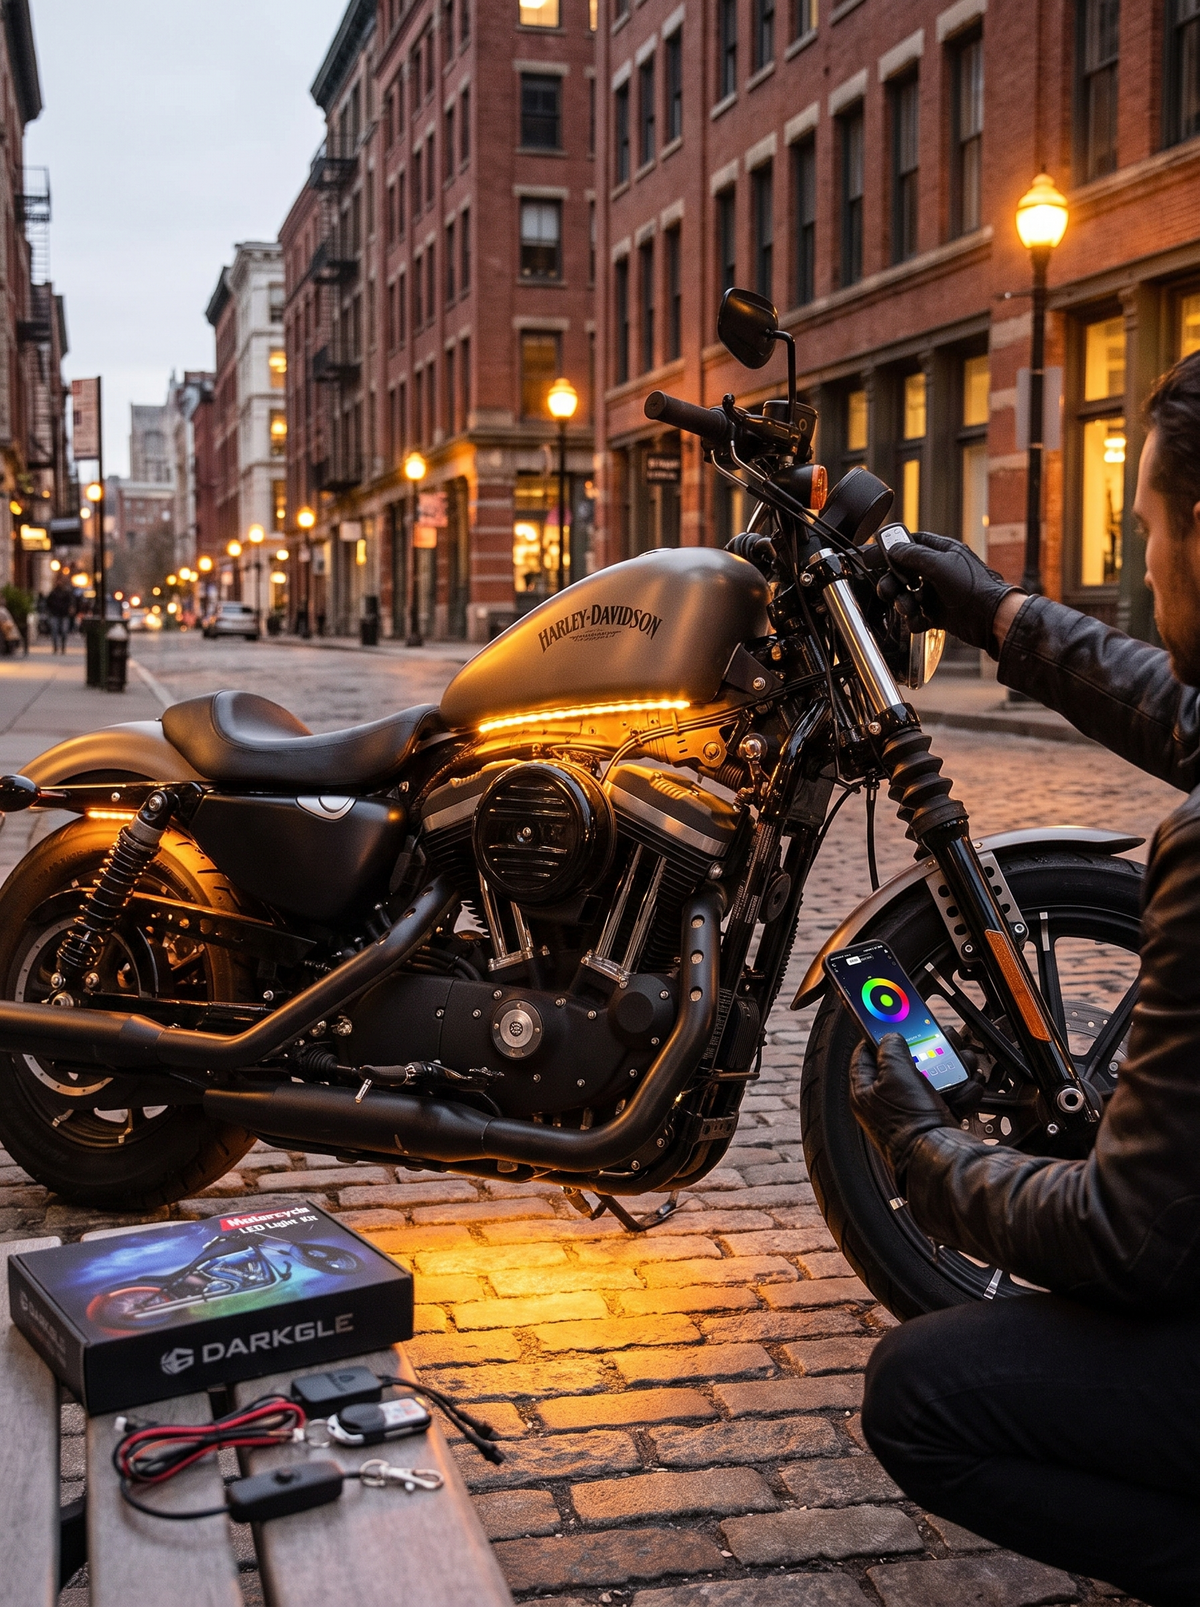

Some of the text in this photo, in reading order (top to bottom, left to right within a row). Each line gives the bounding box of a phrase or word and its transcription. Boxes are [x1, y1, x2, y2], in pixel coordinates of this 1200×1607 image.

[239, 1224, 265, 1234] LED
[265, 1218, 298, 1228] Light
[202, 1313, 354, 1363] DARKGLE
